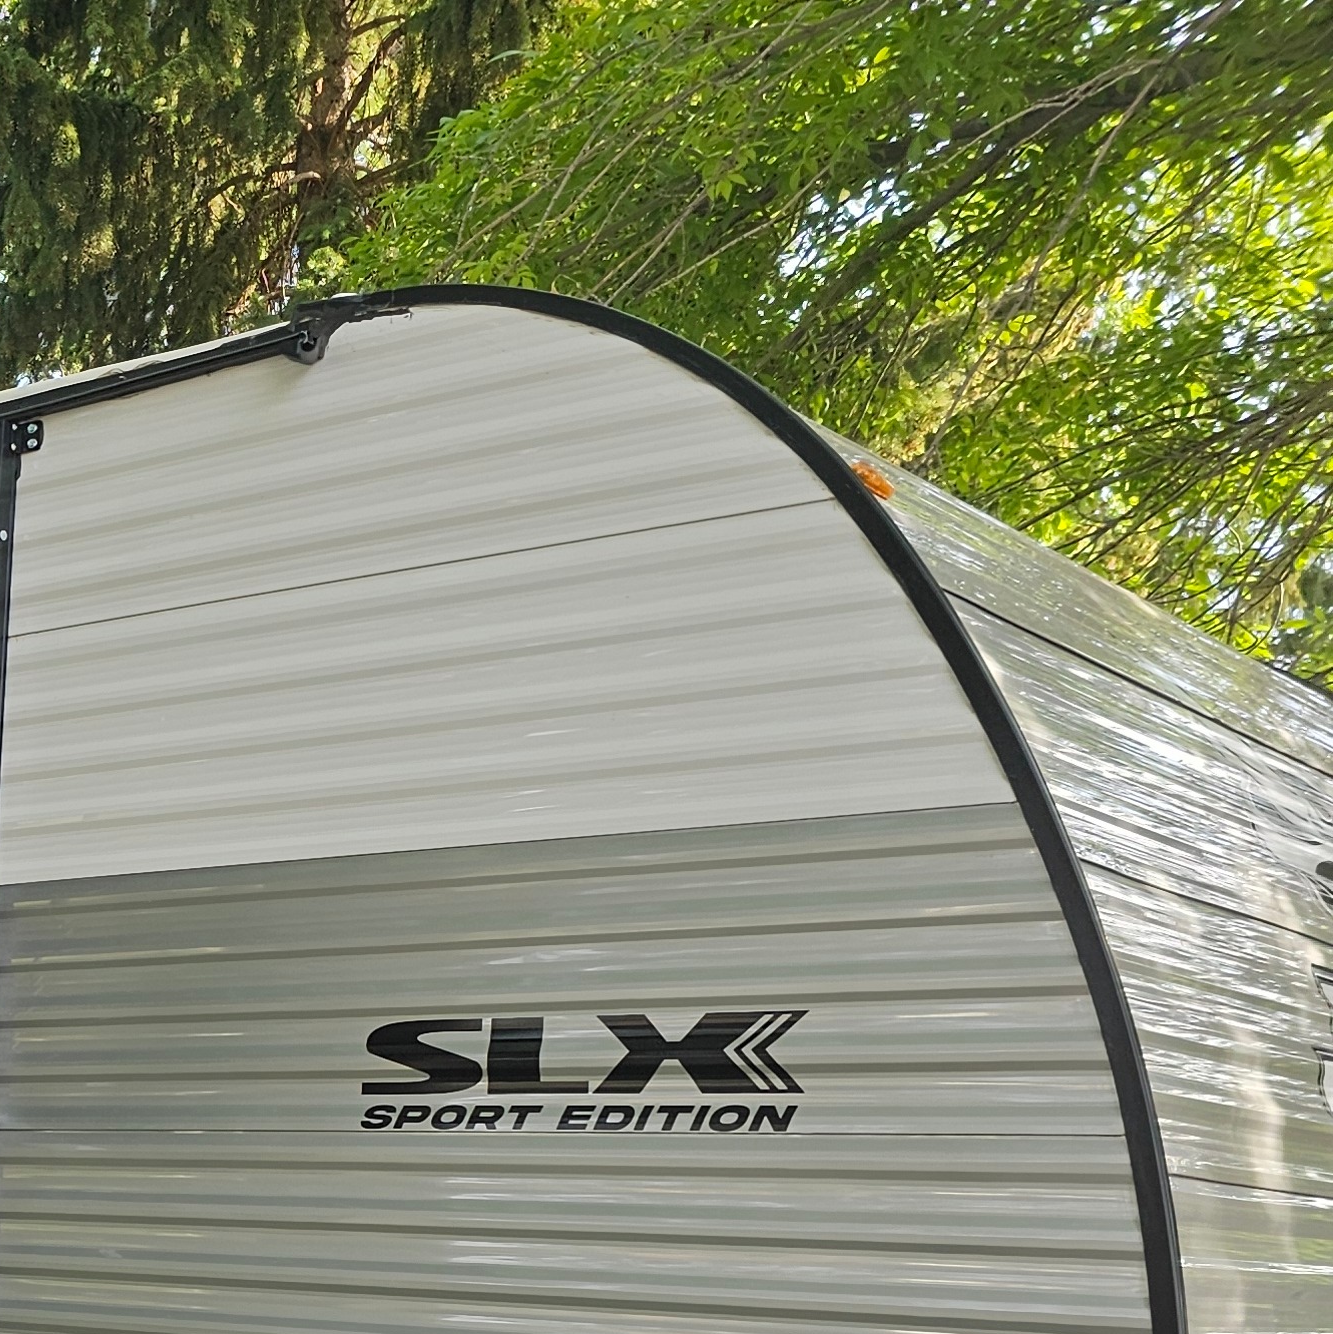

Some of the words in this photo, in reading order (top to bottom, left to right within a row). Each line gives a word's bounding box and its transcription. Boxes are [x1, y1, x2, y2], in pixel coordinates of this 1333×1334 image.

[361, 1009, 809, 1095] SLX
[361, 1104, 543, 1131] SPORT
[556, 1104, 798, 1132] EDITION
